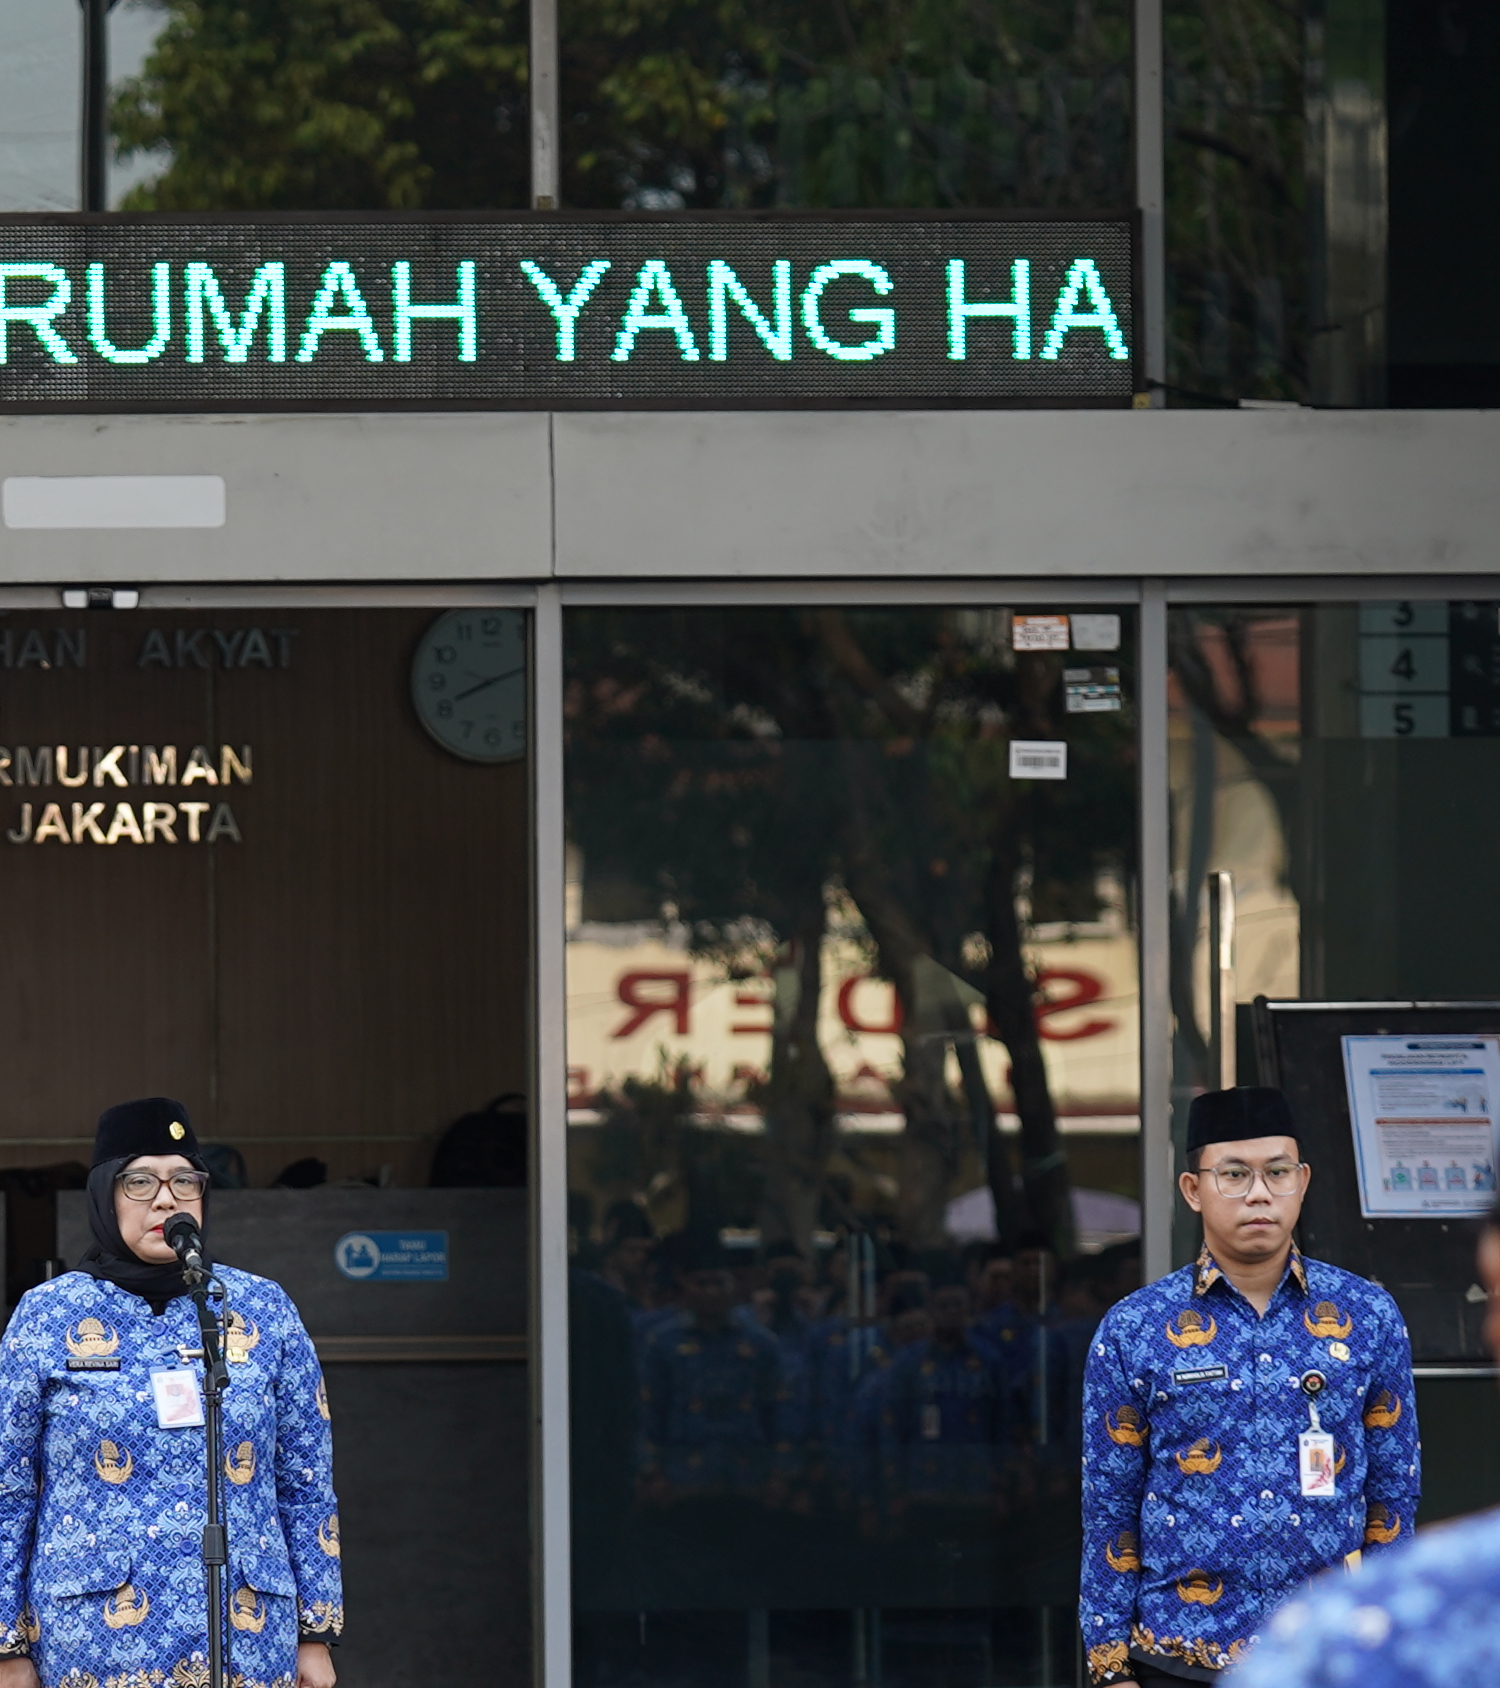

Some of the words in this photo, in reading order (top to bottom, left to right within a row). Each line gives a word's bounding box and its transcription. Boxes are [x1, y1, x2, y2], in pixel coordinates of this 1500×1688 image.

[520, 259, 895, 361] YANG
[945, 259, 1128, 360] HA
[1391, 648, 1416, 681] 4
[460, 720, 474, 738] 7
[1394, 703, 1415, 735] 5
[6, 801, 243, 846] JAKARTA
